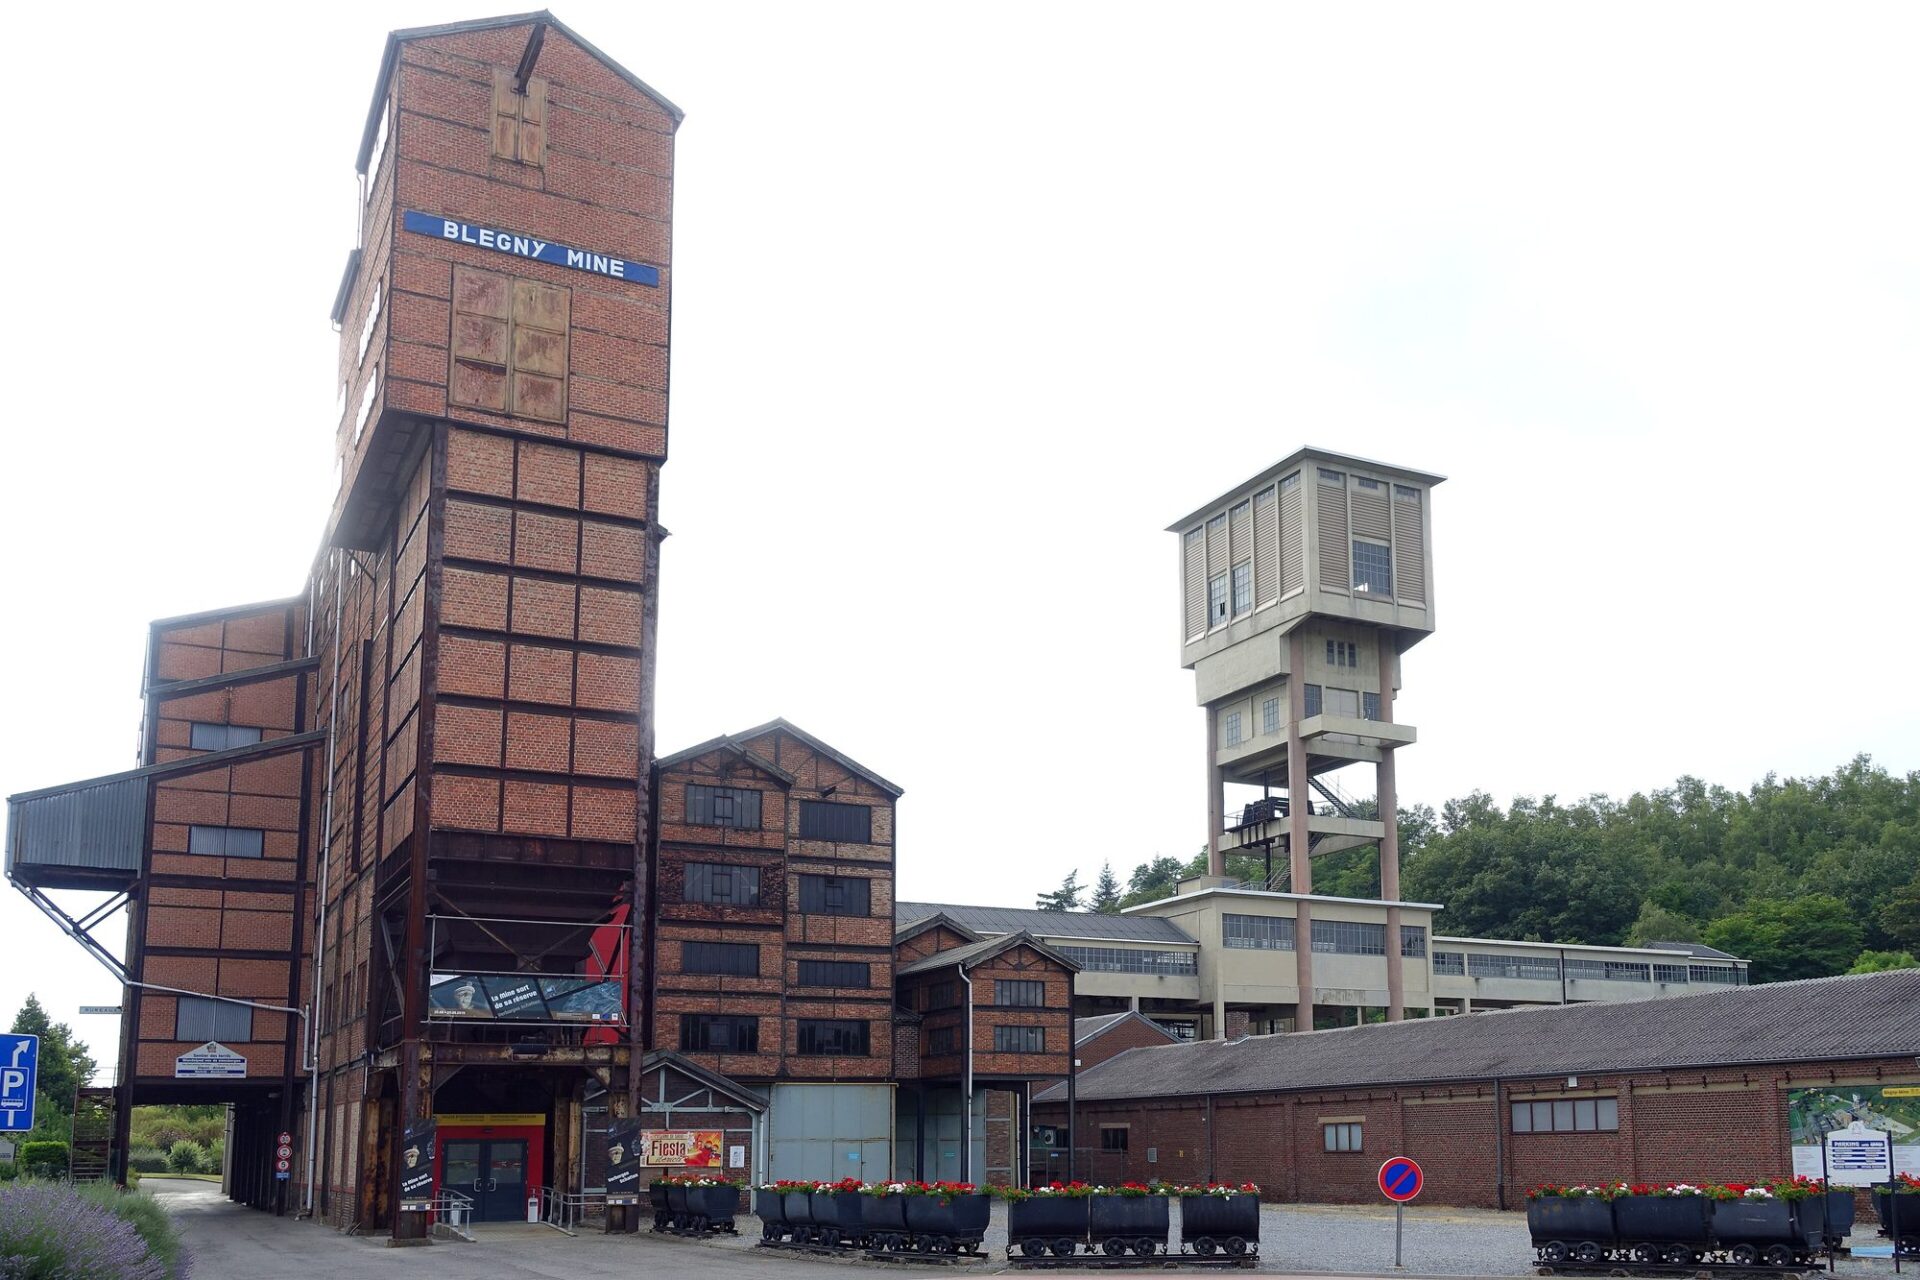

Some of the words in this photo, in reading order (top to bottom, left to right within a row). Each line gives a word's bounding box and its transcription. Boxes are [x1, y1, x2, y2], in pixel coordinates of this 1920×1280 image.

[443, 220, 546, 258] BLEGNY
[567, 249, 624, 278] MINE
[516, 984, 530, 994] sort
[494, 1001, 503, 1010] de
[2, 1070, 25, 1097] P
[651, 1140, 686, 1156] Fiesta
